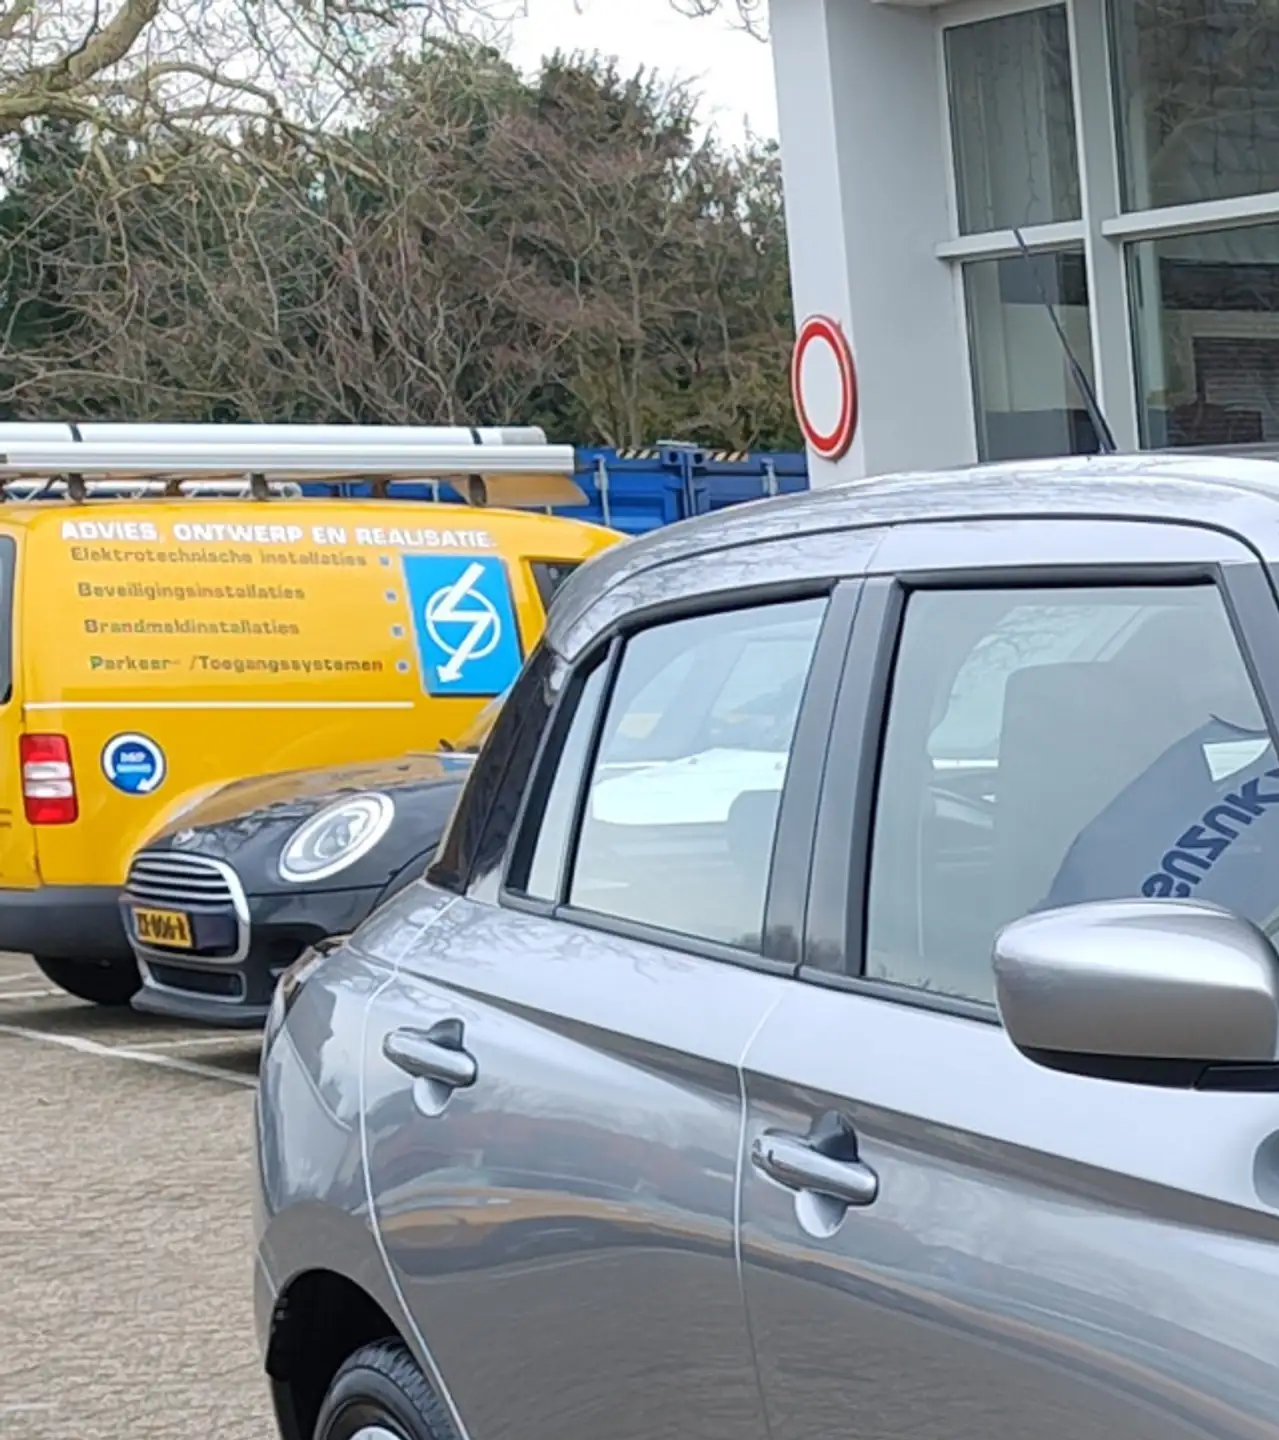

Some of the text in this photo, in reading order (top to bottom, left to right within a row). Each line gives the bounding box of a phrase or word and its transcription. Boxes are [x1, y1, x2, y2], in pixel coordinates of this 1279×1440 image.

[173, 523, 302, 543] ONTWERP
[311, 526, 346, 545] EN
[71, 546, 253, 563] Elektrotechnische
[77, 581, 305, 600] Beveiligingsinstallaties
[84, 618, 299, 636] Brandmeldinstallaties
